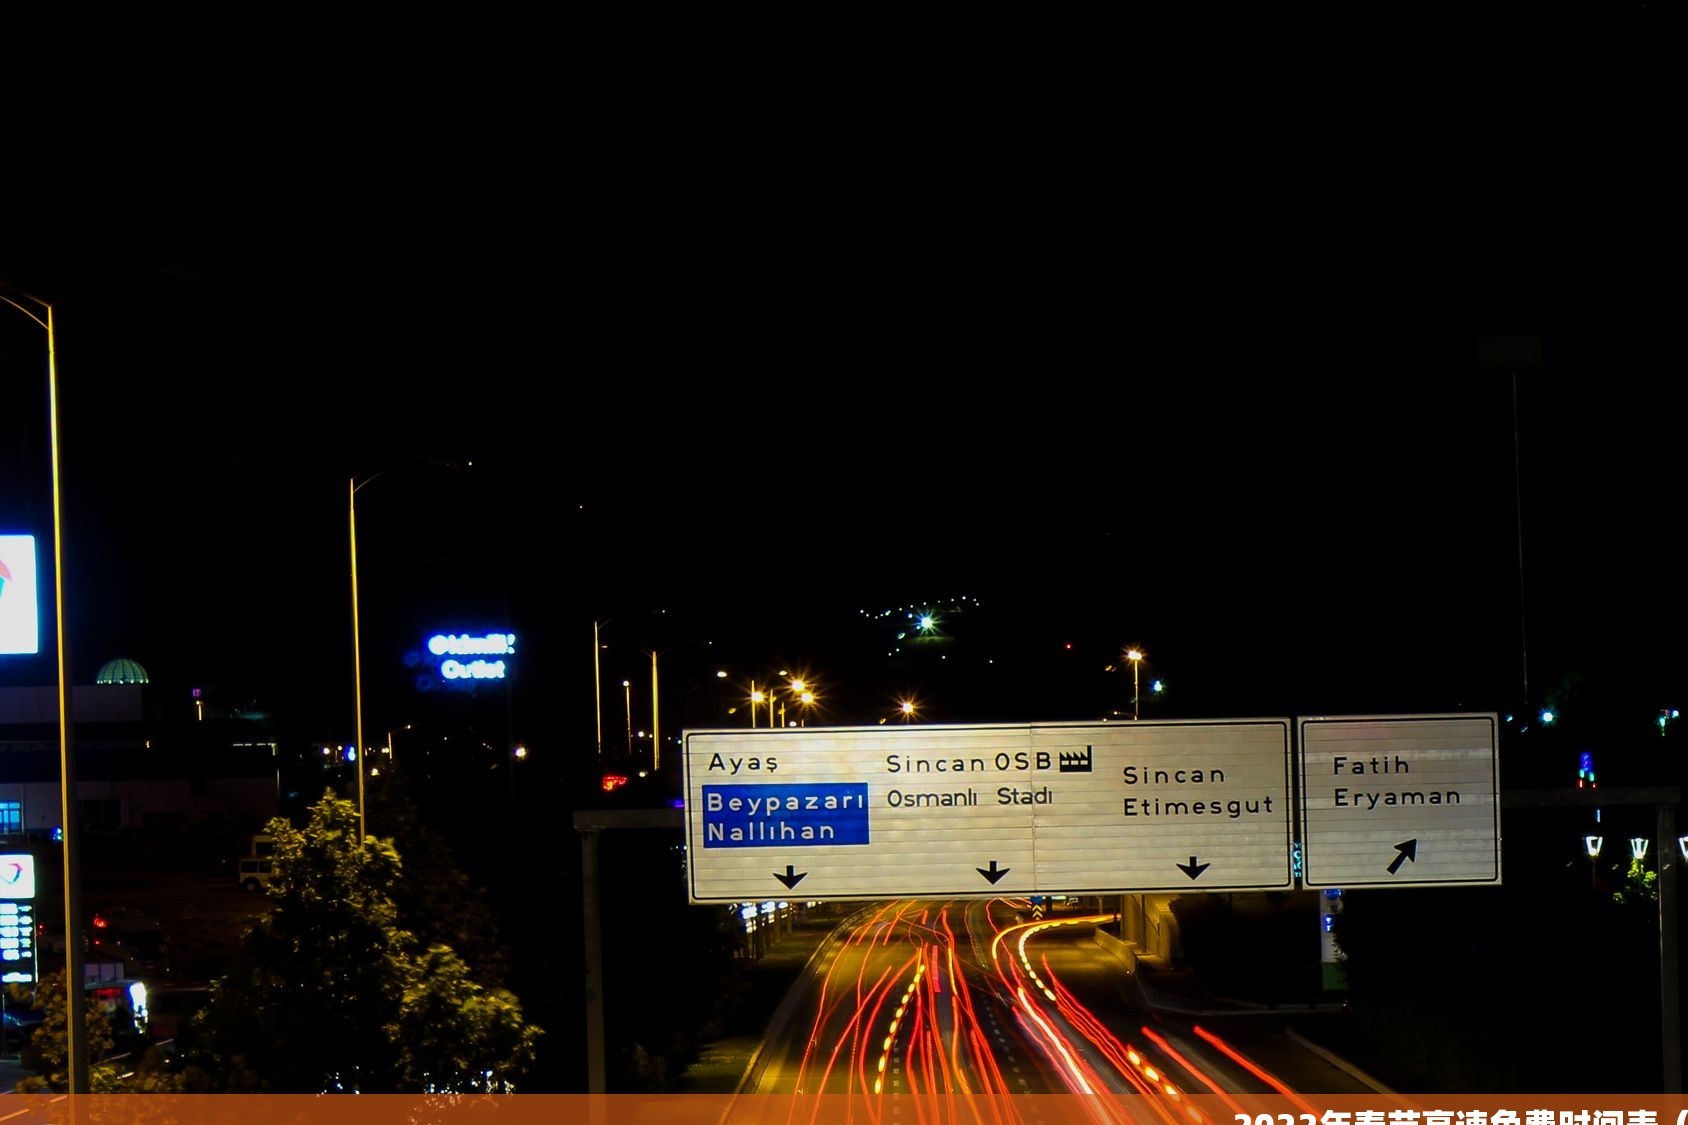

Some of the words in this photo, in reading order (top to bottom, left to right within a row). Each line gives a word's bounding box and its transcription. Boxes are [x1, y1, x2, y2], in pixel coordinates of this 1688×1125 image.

[708, 752, 778, 775] Ayaş
[886, 754, 985, 773] Sincan
[994, 751, 1052, 771] OSB
[1333, 755, 1410, 776] Fatih
[1123, 766, 1226, 785] Sincan
[707, 792, 864, 816] Beypazarı
[887, 788, 978, 808] Osmanlı
[996, 786, 1053, 806] Stadı
[1123, 796, 1273, 819] Etimesgut
[1334, 788, 1461, 811] Eryaman
[708, 821, 835, 842] Nallıhan
